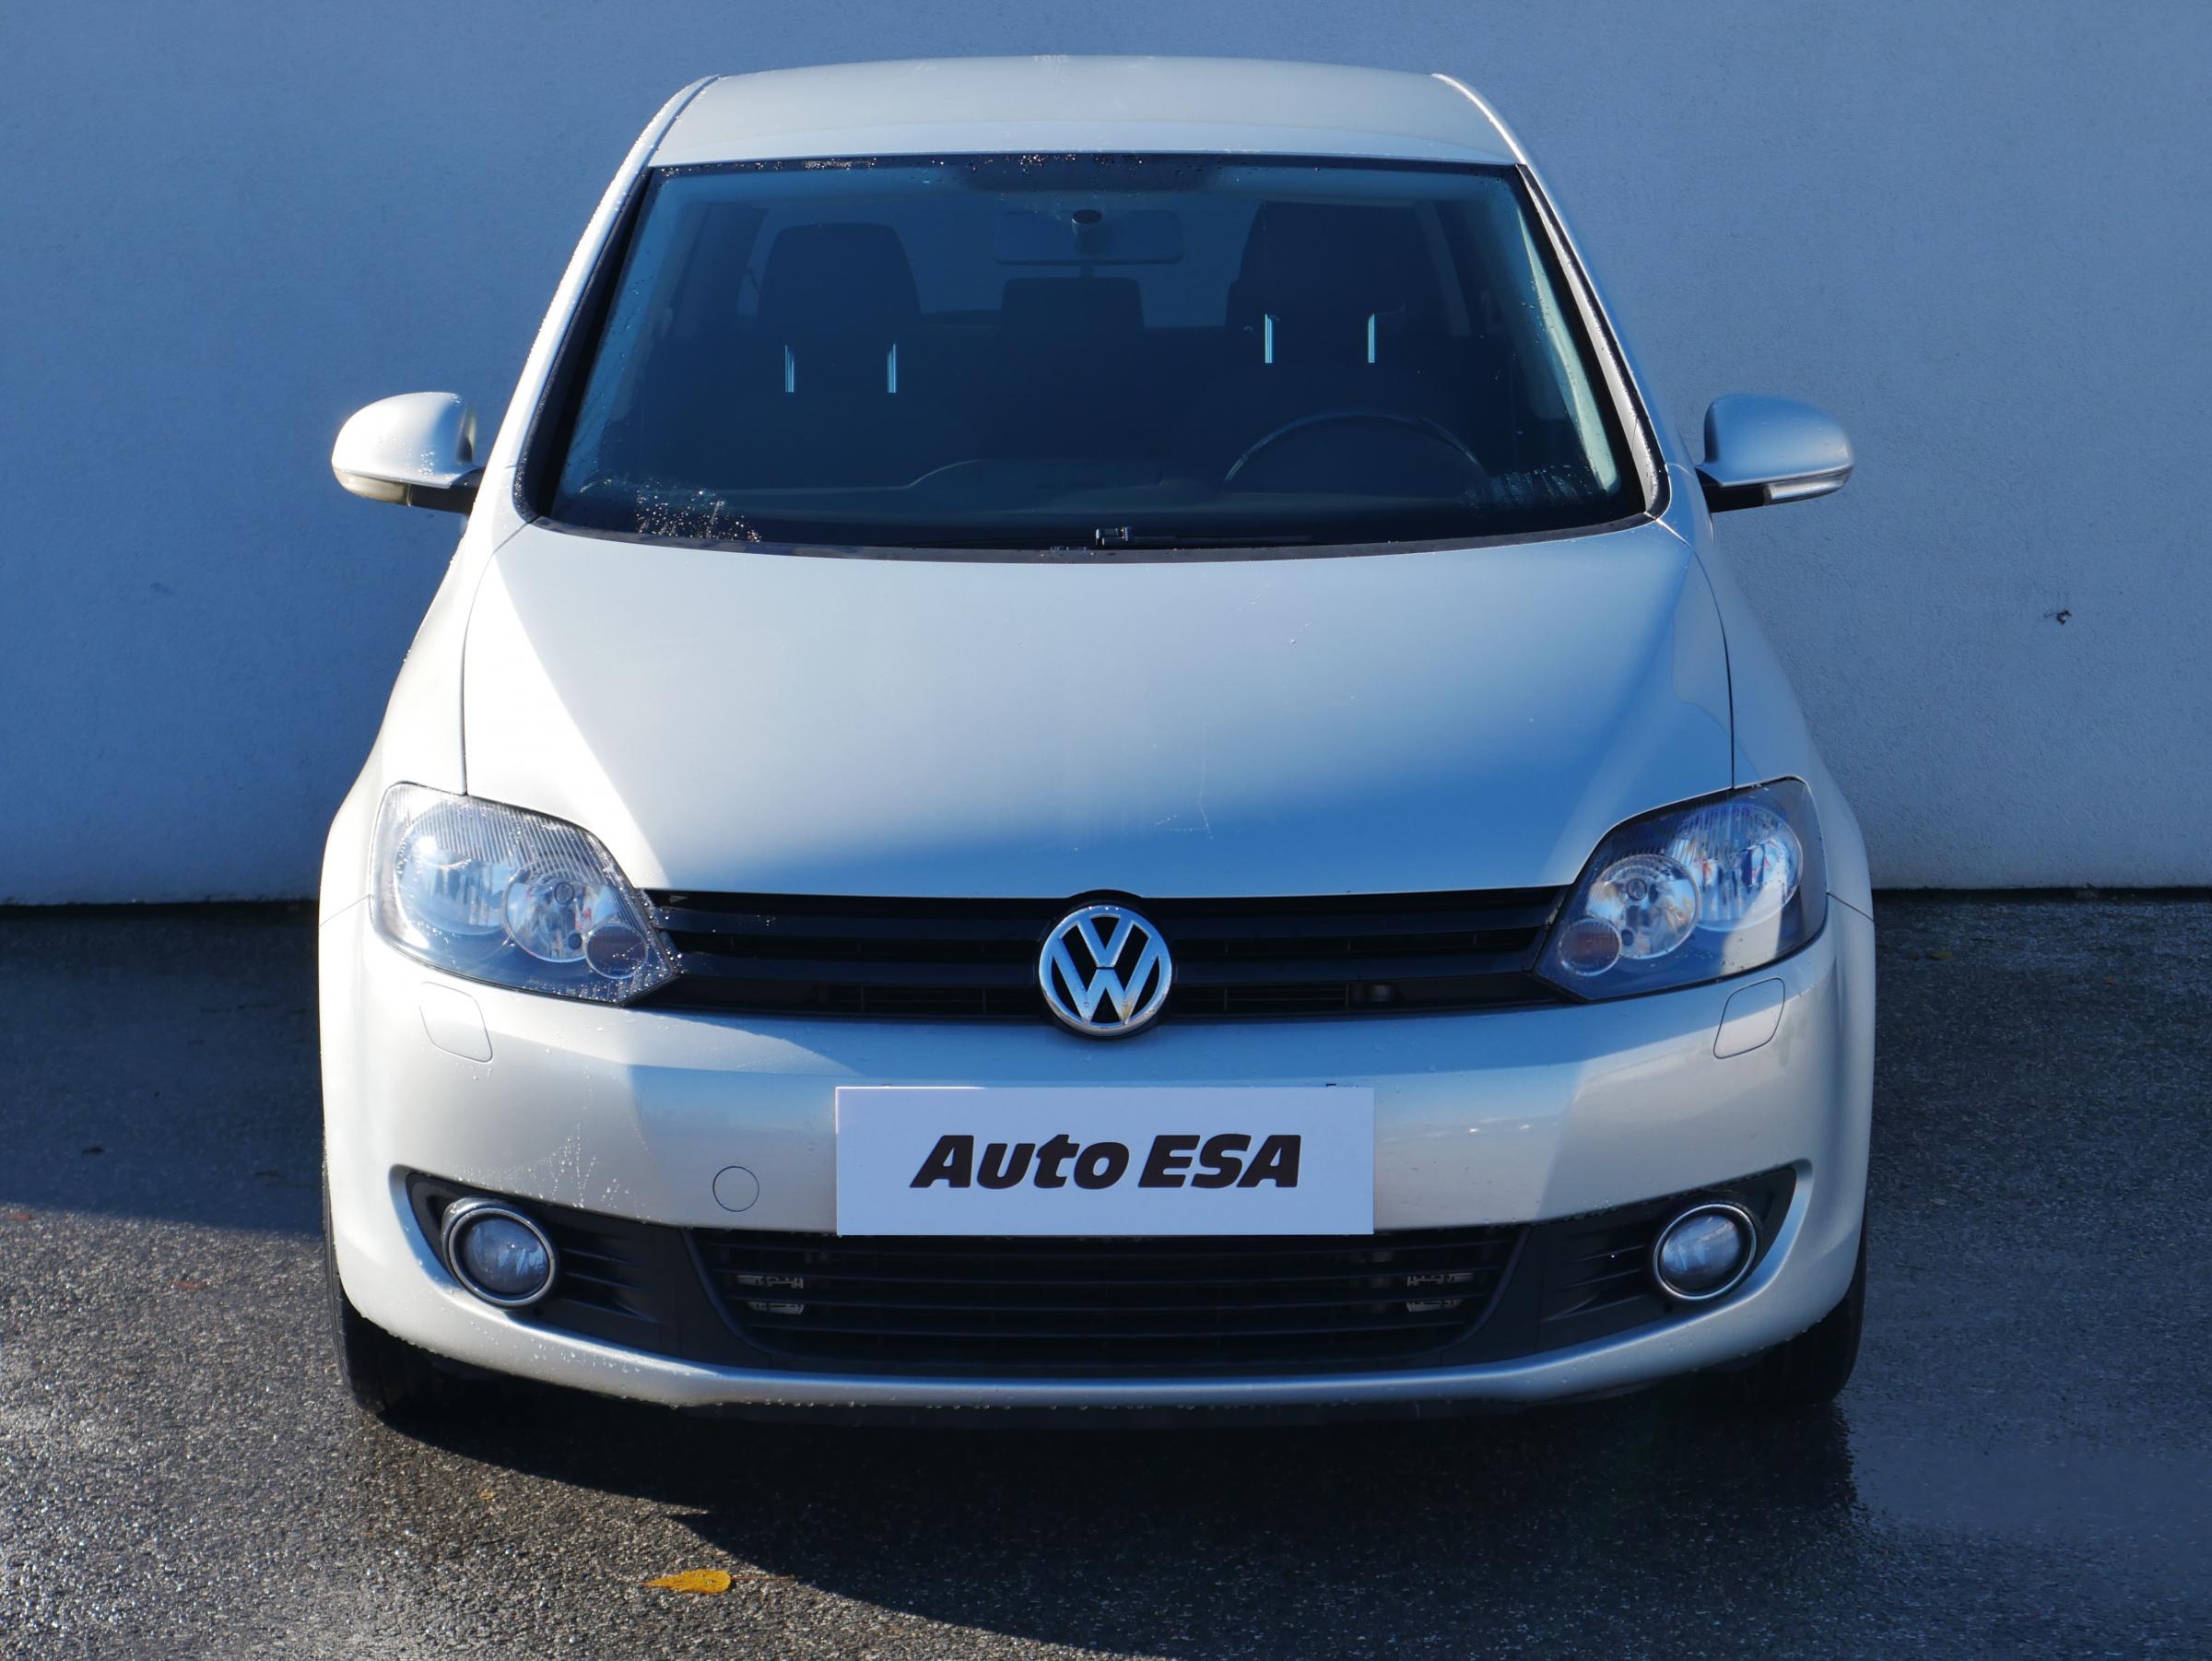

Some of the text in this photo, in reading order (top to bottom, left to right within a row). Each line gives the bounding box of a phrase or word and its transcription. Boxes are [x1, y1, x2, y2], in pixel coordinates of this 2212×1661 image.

[1042, 909, 1169, 1028] VW
[910, 1134, 1301, 1189] Auto ESA
